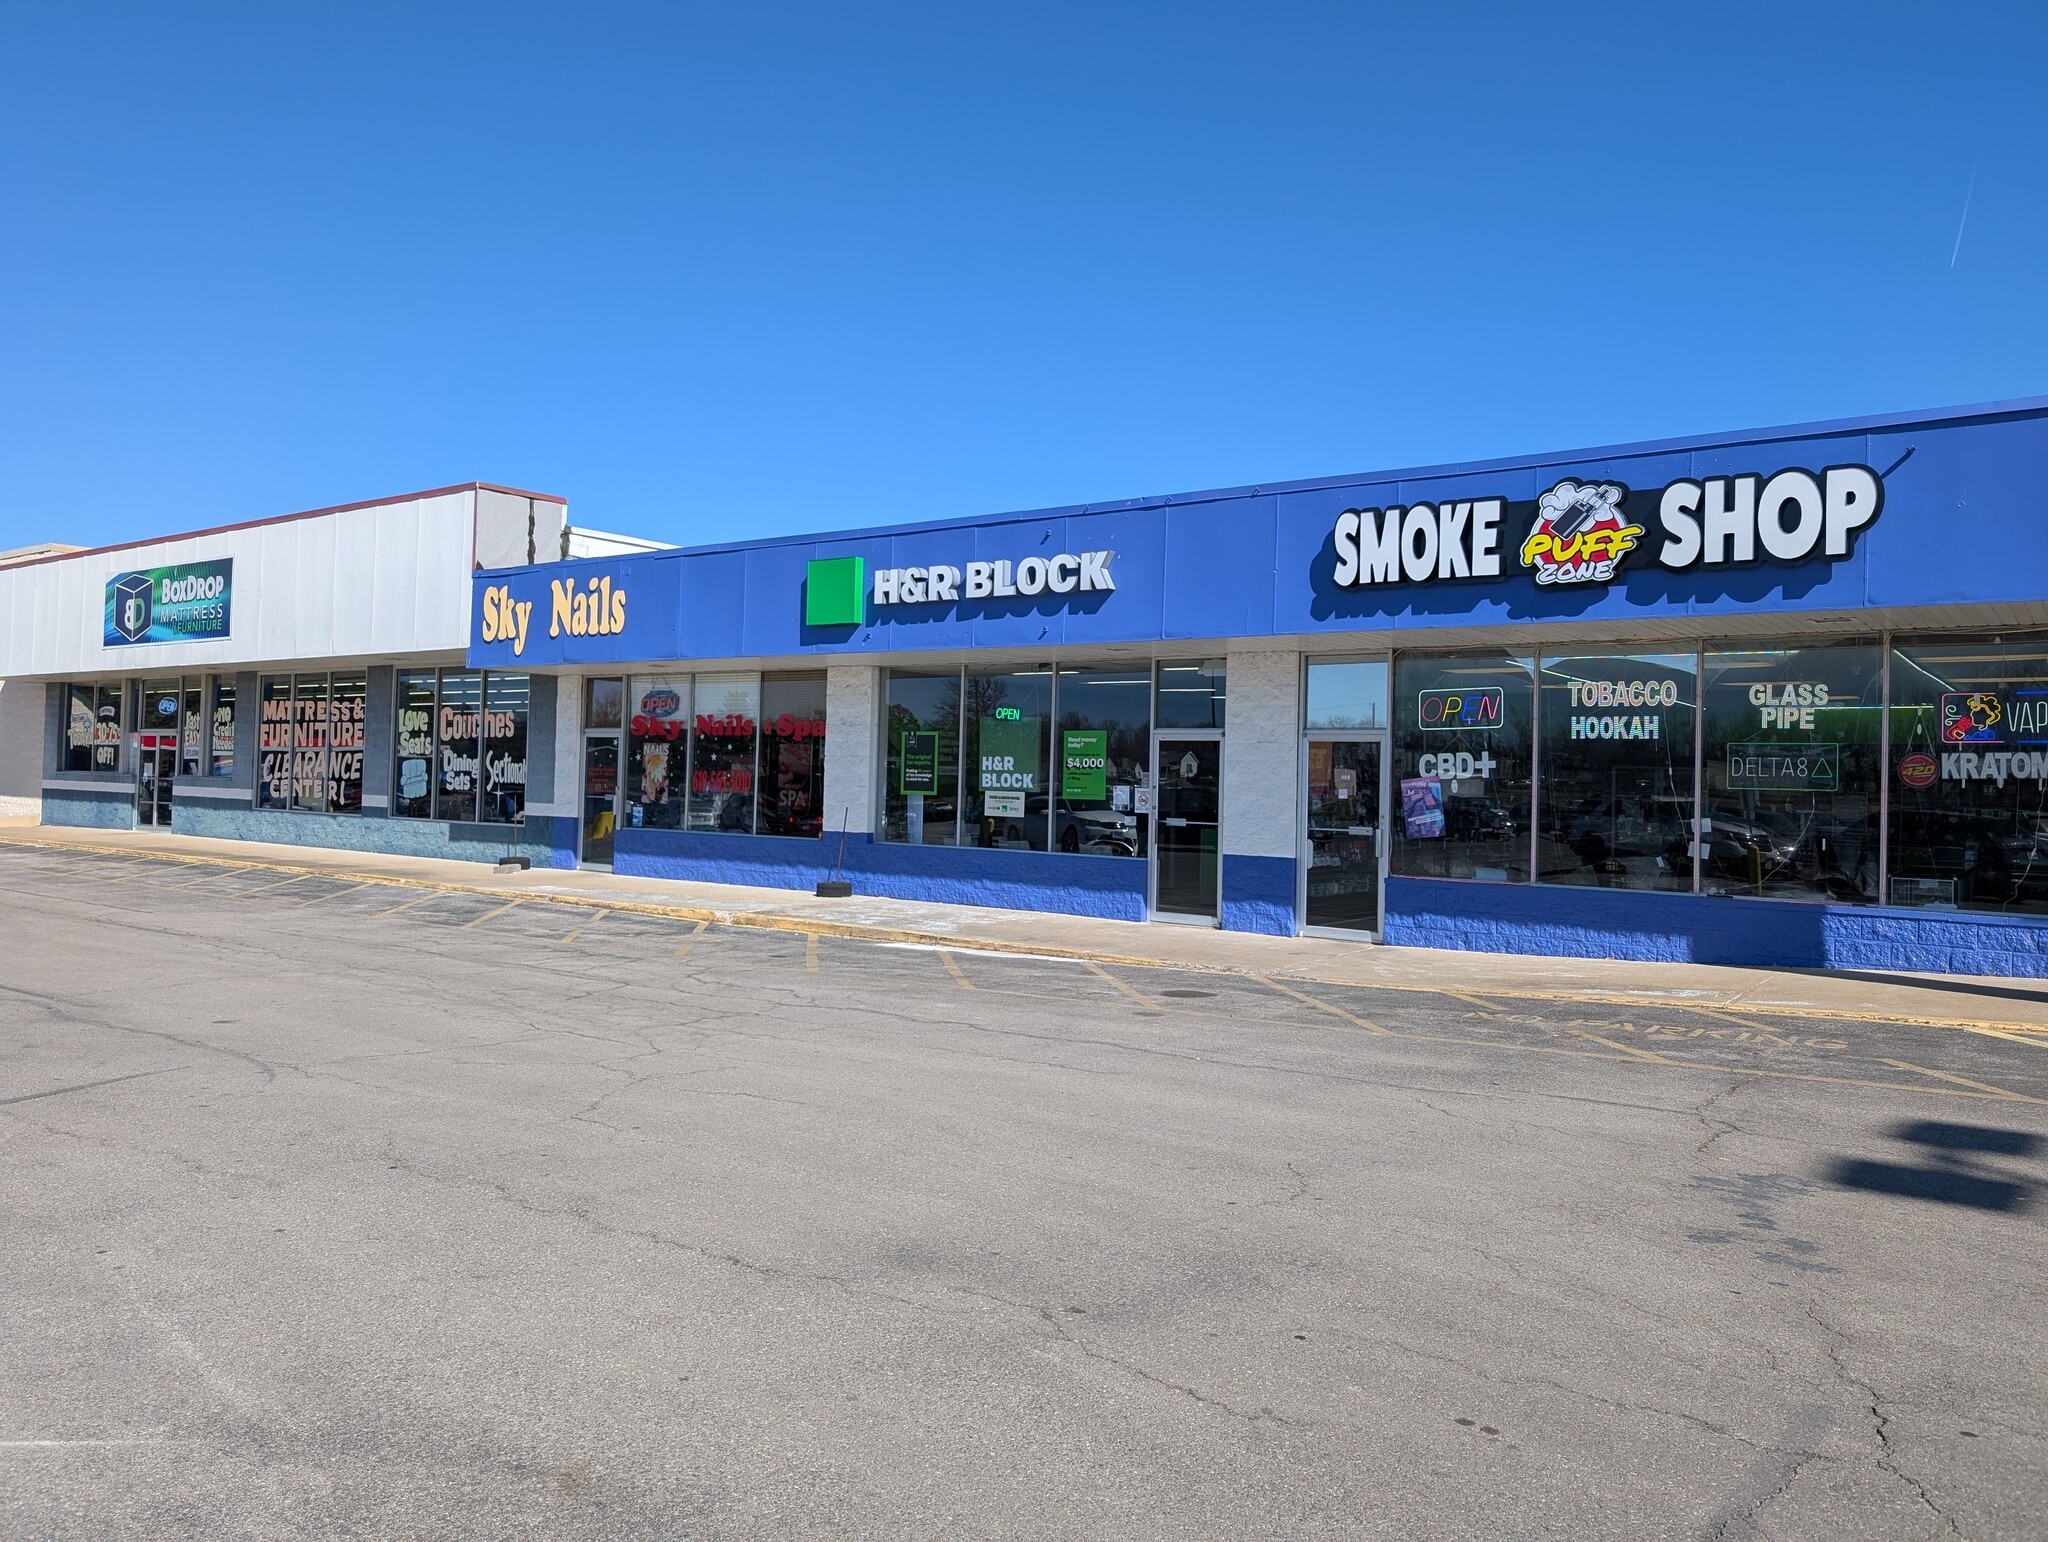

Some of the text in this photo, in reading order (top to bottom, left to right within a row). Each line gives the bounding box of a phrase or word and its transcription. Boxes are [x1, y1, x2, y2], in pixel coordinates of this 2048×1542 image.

[1333, 467, 1878, 587] SMOKE SHOP
[1523, 525, 1642, 565] PUFF
[873, 550, 1117, 605] H&R BLOCK
[1540, 560, 1613, 581] ZONE
[160, 603, 223, 622] MATTRESS
[482, 575, 626, 656] Sky Nails
[160, 698, 176, 712] OPEN
[641, 695, 677, 712] OPEN
[1567, 680, 1678, 707] TOBACCO
[1748, 683, 1829, 706] GLASS
[186, 711, 201, 730] Fast
[263, 697, 365, 722] MATTRESS &
[398, 708, 429, 733] Love
[995, 707, 1020, 720] OPEN
[1421, 695, 1501, 723] OPEN
[1760, 707, 1815, 730] PIPE
[2006, 701, 2048, 734] VAP
[213, 721, 234, 737] Credit
[260, 722, 364, 747] FURNITURE
[440, 706, 514, 741] Couches
[630, 714, 685, 740] Sky
[694, 713, 754, 737] Nails
[776, 713, 826, 742] Spa
[1570, 716, 1660, 740] HOOKAH
[184, 731, 200, 747] EASY
[400, 732, 432, 756] Seats
[643, 744, 670, 756] NAILS
[97, 746, 114, 766] OFF!
[263, 751, 363, 782] CLEARANCE
[443, 749, 479, 779] Dining
[982, 756, 1015, 771] H&R
[1067, 757, 1104, 768] $4,000
[1418, 751, 1497, 780] CBD+
[1941, 751, 2048, 780] KRATOM
[446, 771, 470, 791] Sets
[981, 773, 1034, 789] BLOCK
[1902, 765, 1936, 777] 420
[270, 779, 345, 806] CENTER!
[779, 790, 807, 807] SPA
[1565, 1018, 1850, 1050] PARKING
